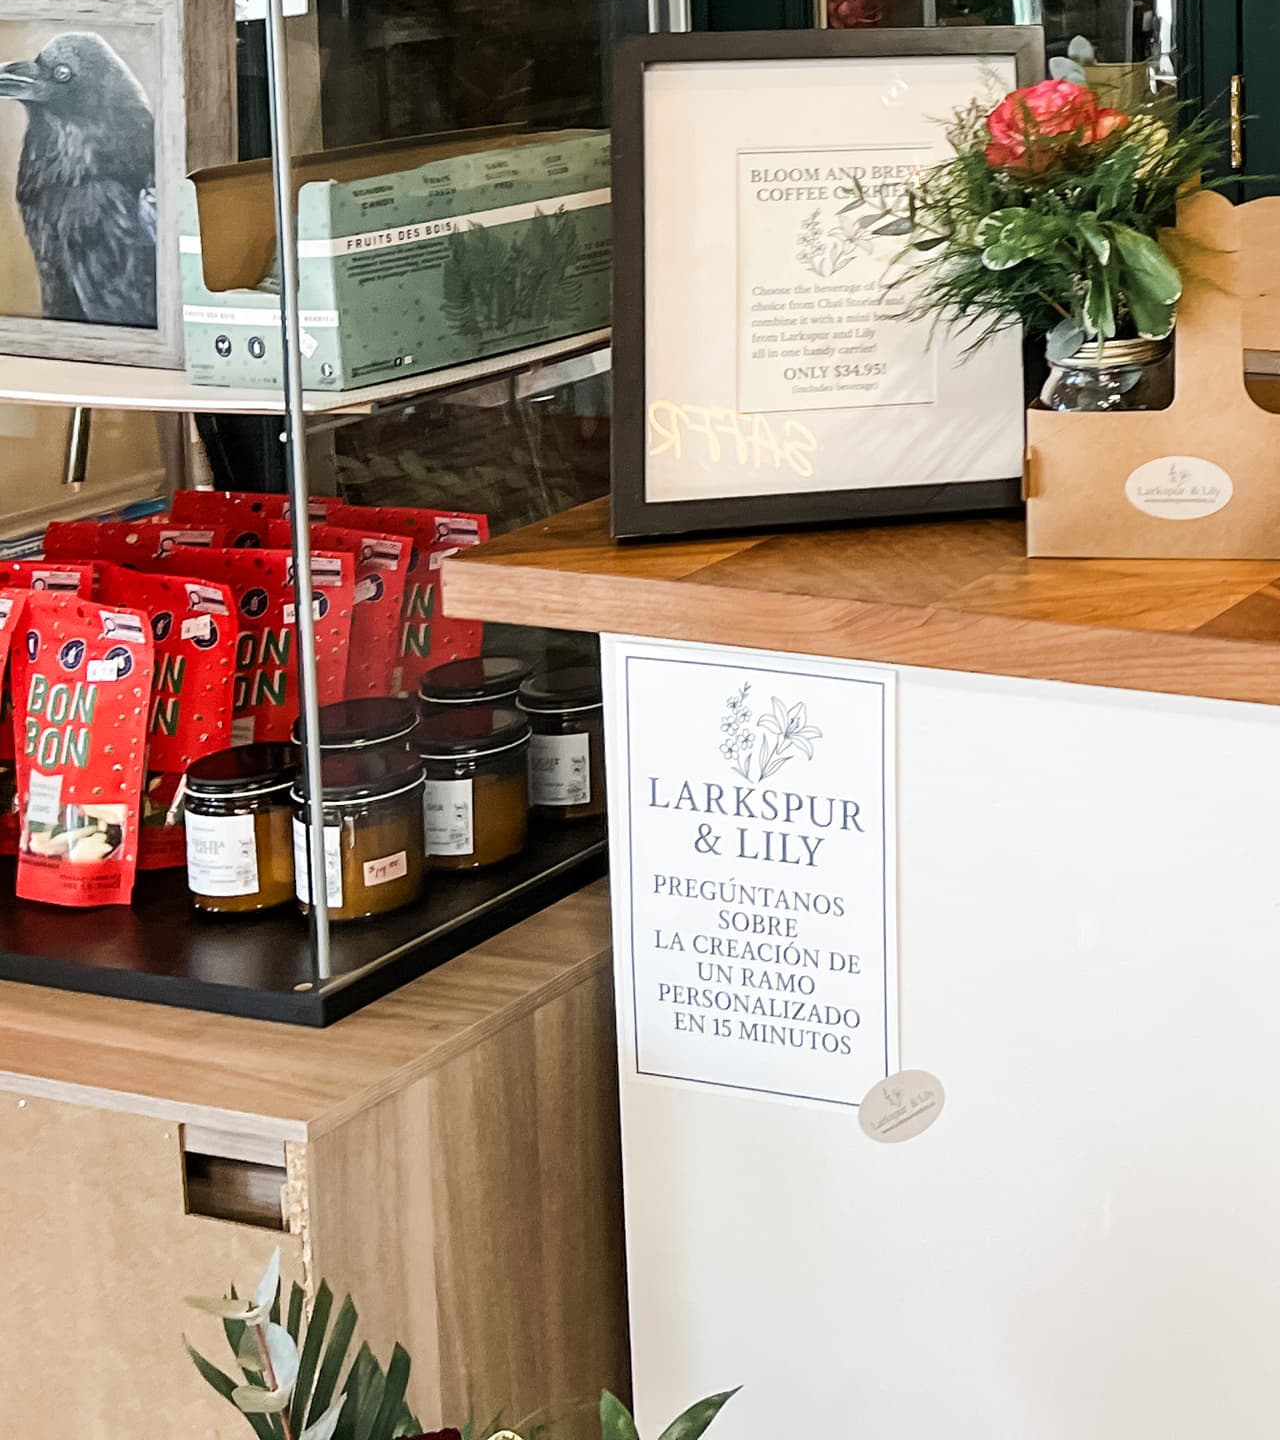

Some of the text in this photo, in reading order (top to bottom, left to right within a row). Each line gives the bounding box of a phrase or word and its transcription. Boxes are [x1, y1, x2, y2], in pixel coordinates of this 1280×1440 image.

[751, 167, 820, 183] BLOOM
[825, 166, 866, 180] AND
[756, 184, 914, 201] COFFEE CRRIE
[347, 222, 453, 250] FRUITS DES BOIS
[752, 286, 791, 297] Choose
[794, 285, 811, 295] the
[814, 283, 861, 295] beverage
[752, 300, 785, 312] choice
[789, 300, 815, 310] from
[752, 316, 797, 328] combine
[811, 315, 835, 325] with
[752, 327, 876, 343] from Larkspur and Lily
[752, 348, 765, 359] all
[768, 347, 778, 358] in
[781, 348, 800, 357] one
[803, 345, 835, 357] handy
[783, 363, 887, 381] ONLY $34.95!
[1137, 486, 1185, 496] Larkspur
[27, 673, 99, 724] BON
[26, 717, 90, 769] BON
[648, 776, 865, 832] LARKSPUR
[694, 823, 825, 867] & LILY
[653, 874, 845, 917] PREGÚNTANOS
[718, 909, 799, 938] SOBRE
[654, 929, 861, 974] LA CREACIÓN DE
[696, 961, 815, 995] UN RAMO
[658, 983, 861, 1028] PERSONALIZADO
[674, 1011, 851, 1055] EN 15 MINUTOS
